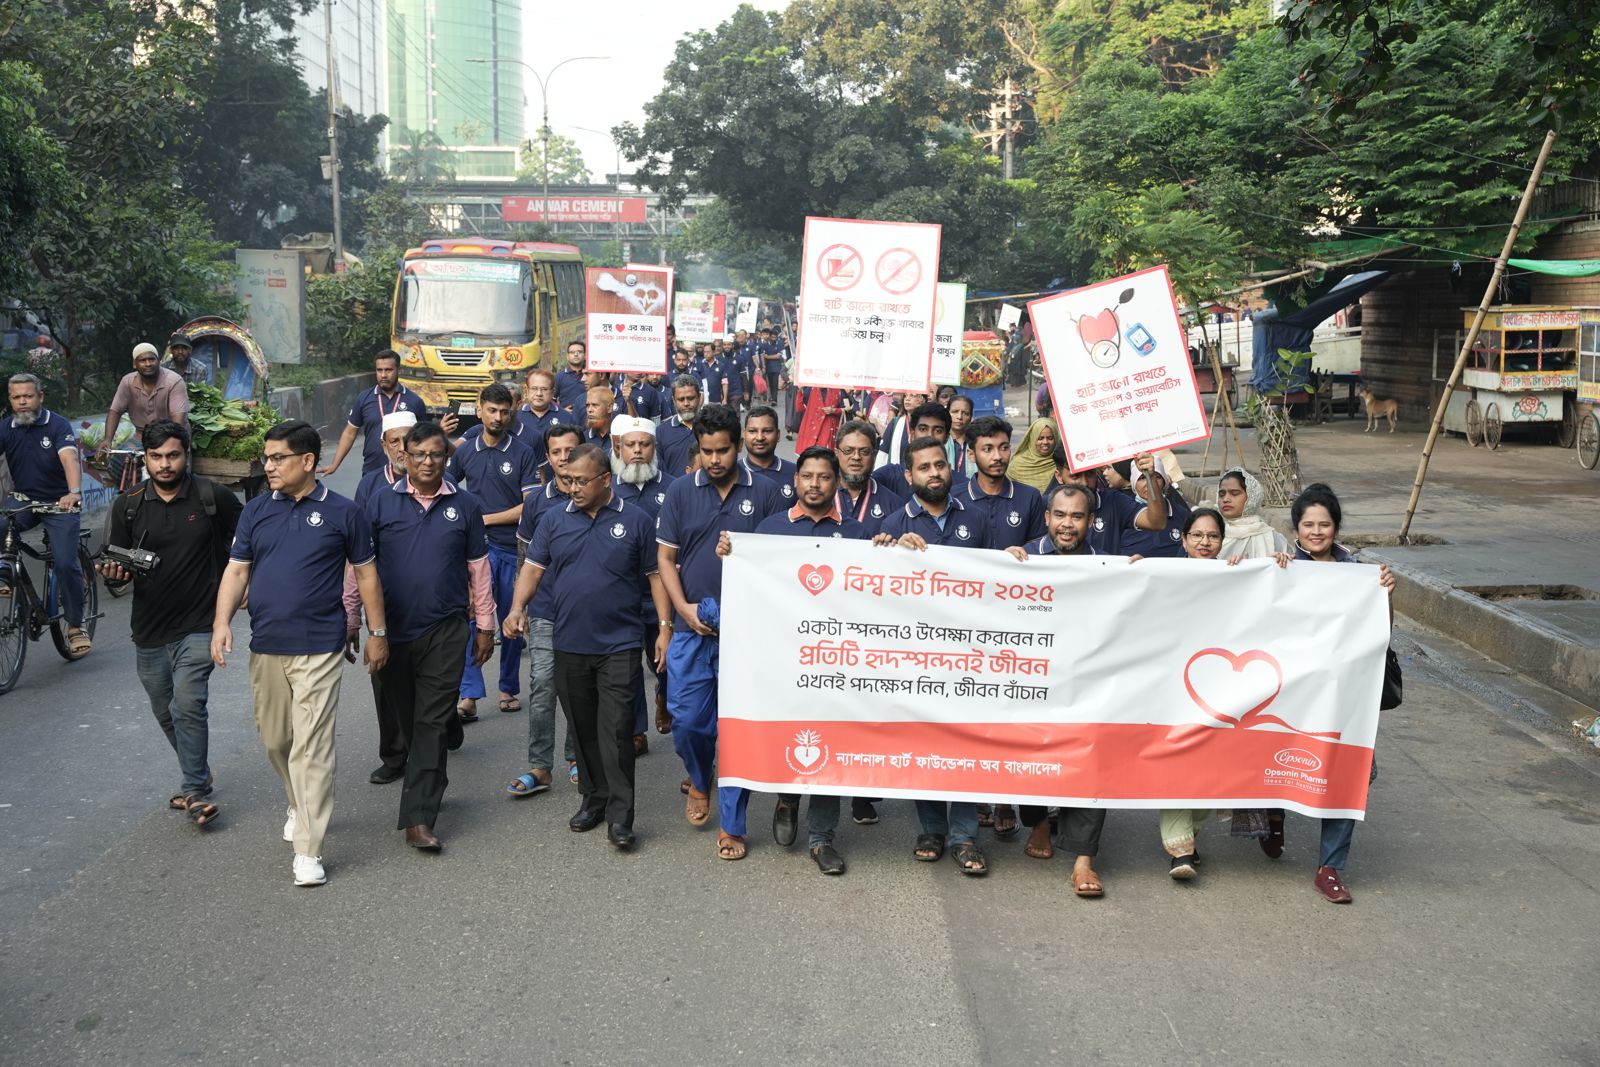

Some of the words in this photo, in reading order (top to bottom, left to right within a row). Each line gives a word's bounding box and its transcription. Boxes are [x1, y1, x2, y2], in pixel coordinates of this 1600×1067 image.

[527, 200, 570, 213] ANWAR
[573, 200, 624, 213] CEMENT
[934, 334, 953, 344] জন্য
[936, 347, 956, 358] রাখুন
[1098, 375, 1130, 392] ভালো
[1131, 365, 1167, 383] রাখতে
[1124, 391, 1133, 400] ও
[843, 565, 886, 597] বিশ্ব
[889, 569, 927, 596] হার্ট
[930, 571, 985, 599] দিবস
[994, 582, 1055, 602] ২০২৫
[797, 617, 843, 637] একটা
[846, 621, 912, 640] স্পন্দনও
[916, 621, 973, 643] উপেক্ষা
[975, 629, 1034, 647] করবেন
[1037, 633, 1055, 648] না
[798, 639, 861, 667] প্রতিটি
[864, 648, 985, 675] হৃদস্পন্দনই
[988, 649, 1051, 677] জীবন
[796, 671, 846, 692] এখনই
[849, 677, 913, 695] পদক্ষেপ
[916, 675, 950, 699] নিন,
[953, 676, 1001, 699] জীবন
[1003, 679, 1050, 701] বাঁচান
[835, 752, 887, 768] ন্যাশনাল
[889, 751, 913, 769] হার্ট
[914, 752, 977, 773] ফাউন্ডেশন
[978, 759, 1001, 773] অব
[1003, 760, 1063, 777] বাংলাদেশ
[1264, 768, 1299, 778] Opsonin
[1300, 772, 1328, 784] Pharma
